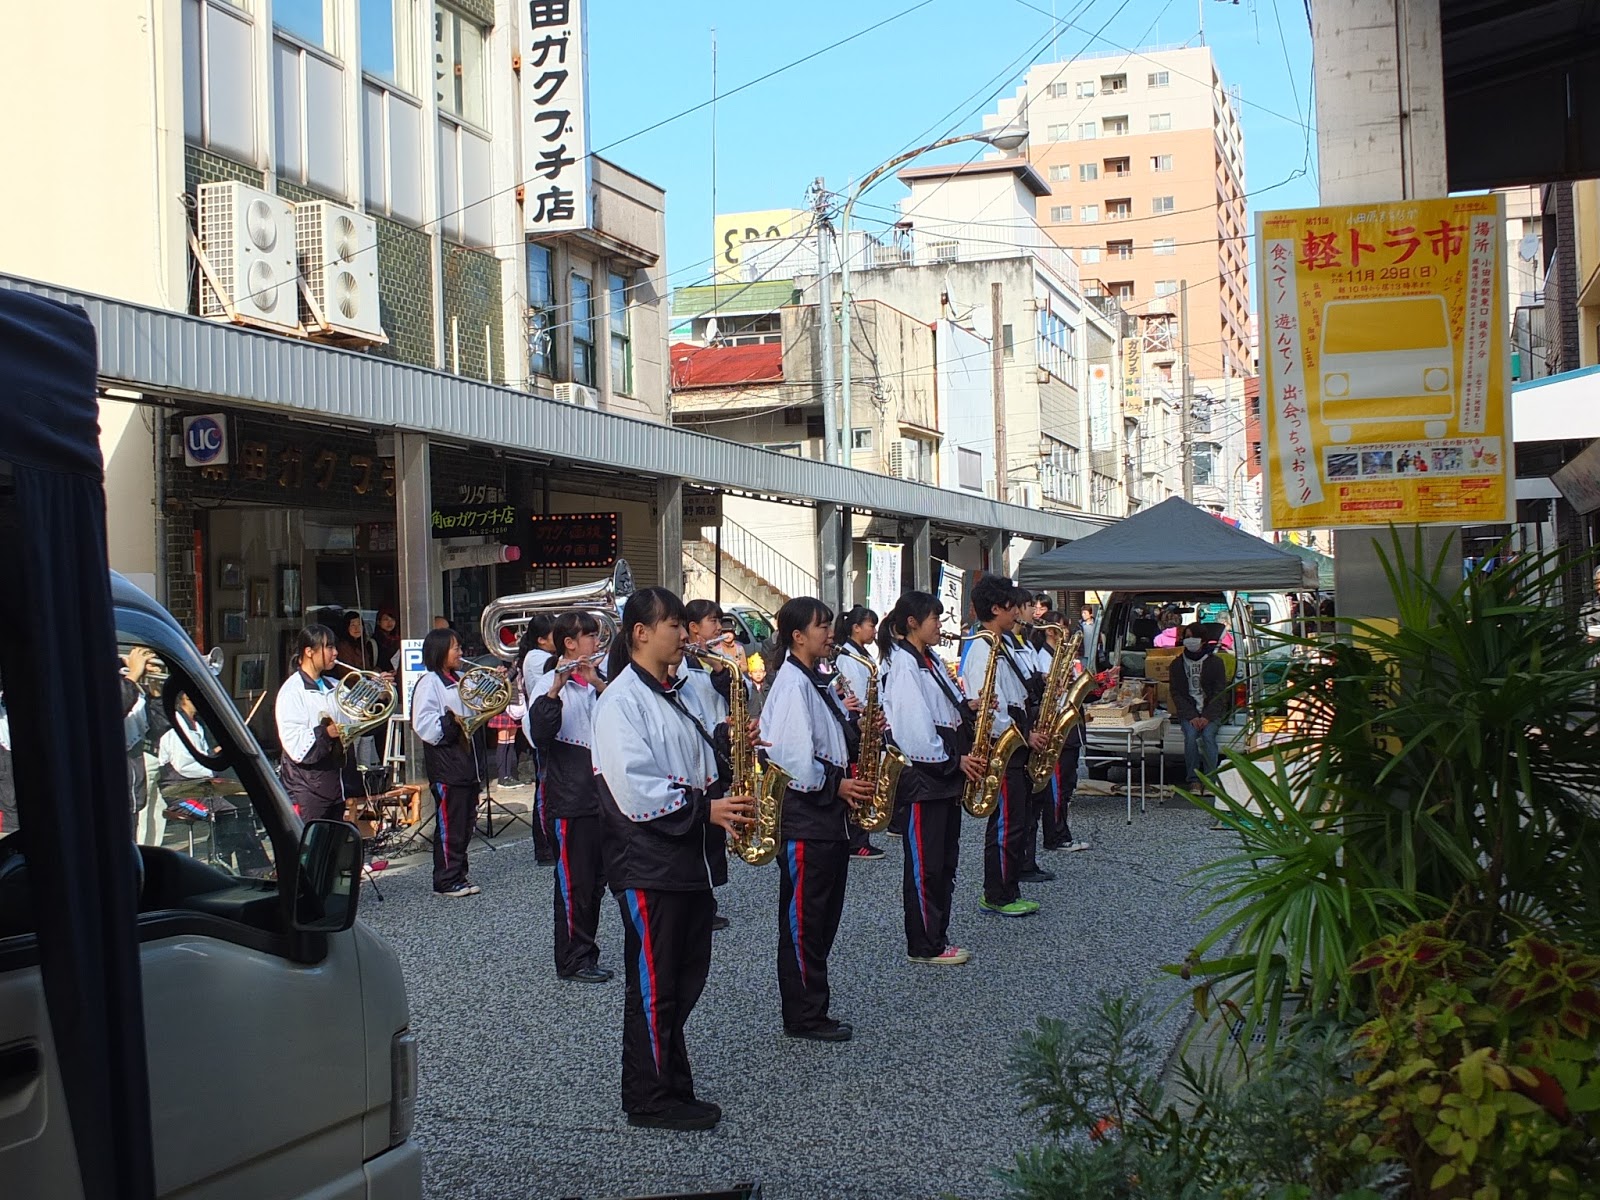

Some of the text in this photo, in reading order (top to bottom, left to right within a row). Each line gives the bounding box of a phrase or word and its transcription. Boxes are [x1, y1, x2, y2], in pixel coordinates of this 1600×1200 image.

[1298, 220, 1469, 271] 軽トラ市
[1473, 221, 1490, 254] 場所
[1128, 340, 1140, 376] ガクブチ
[188, 427, 221, 451] UC
[430, 505, 515, 530] 角田ガクブチ店
